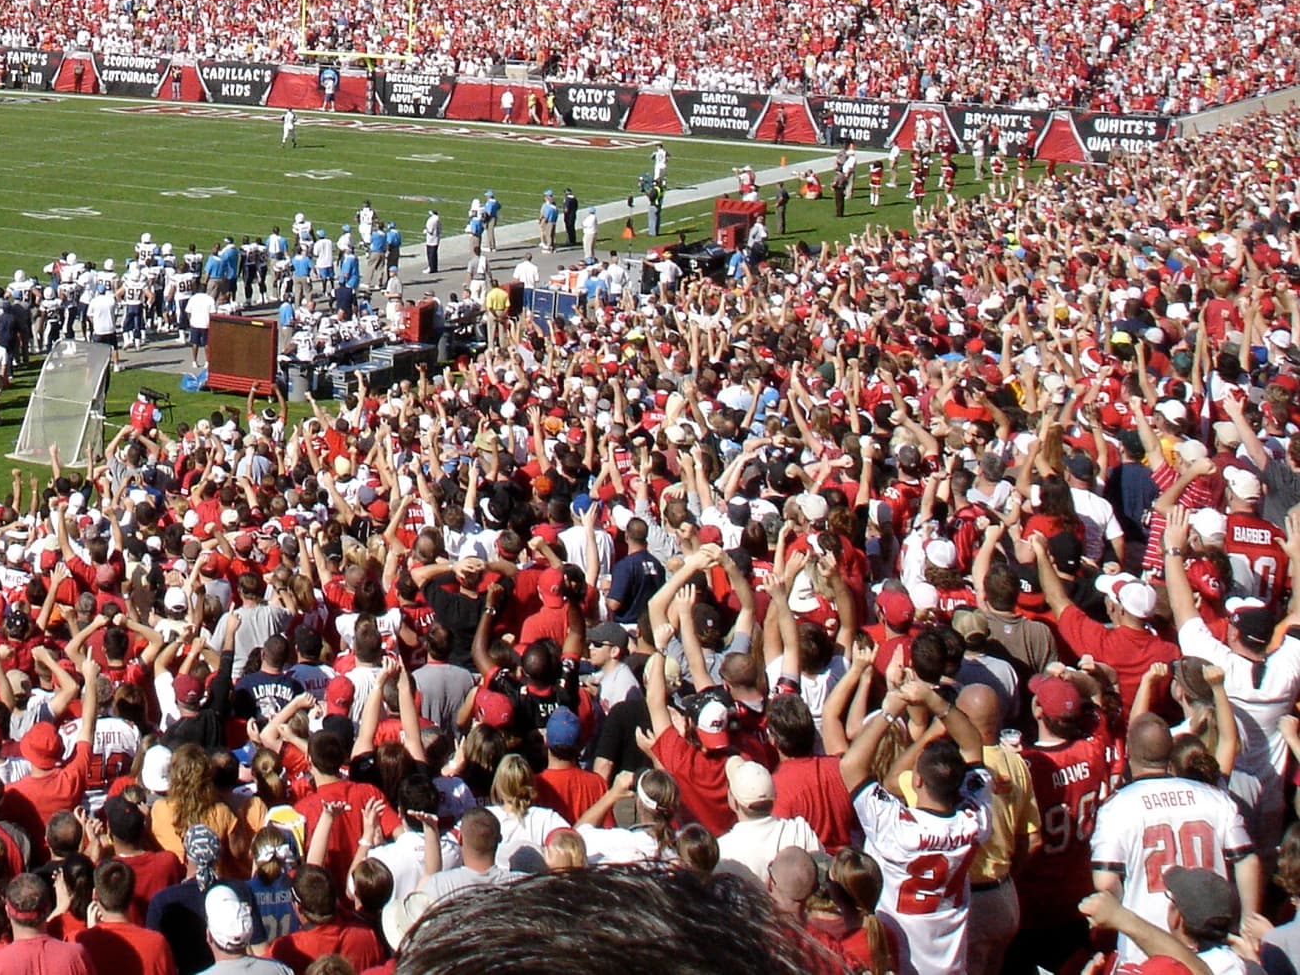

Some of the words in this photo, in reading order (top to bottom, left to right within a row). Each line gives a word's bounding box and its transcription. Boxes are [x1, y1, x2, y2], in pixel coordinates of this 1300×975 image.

[203, 68, 272, 83] CADILLAC'S
[221, 83, 251, 98] KIDS
[568, 88, 616, 105] CATO'S
[702, 92, 738, 105] GARCIA
[397, 104, 426, 115] BOAD
[572, 105, 611, 123] CREW
[693, 104, 718, 116] PASS
[721, 106, 731, 117] IT
[690, 116, 750, 131] FOUNDATION
[964, 112, 1032, 129] BRYANT'S
[1095, 117, 1156, 136] WHITE'S
[1233, 526, 1272, 545] BARBER
[1052, 761, 1090, 791] ADAMS
[1142, 791, 1196, 809] BARBER
[1142, 820, 1215, 893] 20
